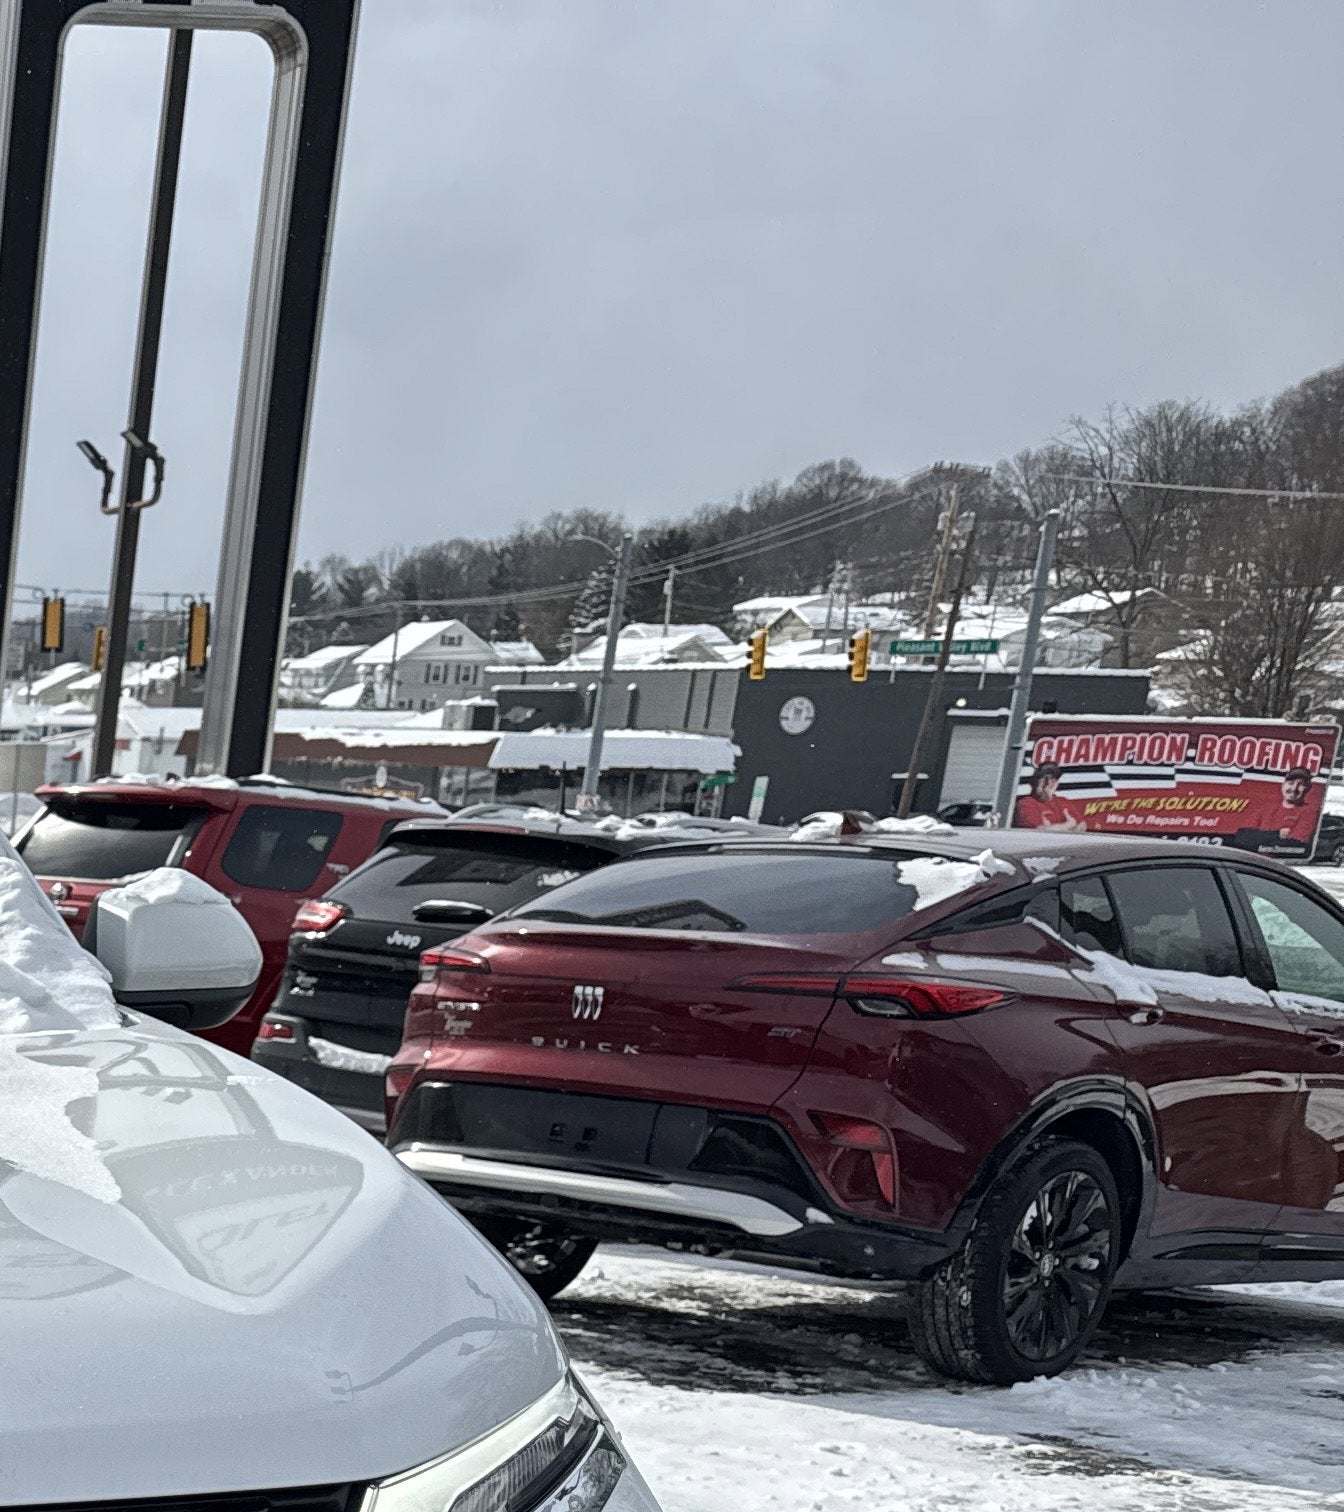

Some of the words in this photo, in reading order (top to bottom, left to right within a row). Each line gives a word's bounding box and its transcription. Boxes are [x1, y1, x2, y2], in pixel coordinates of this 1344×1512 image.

[1031, 732, 1189, 769] CHAMPION
[1195, 733, 1324, 776] ROOFING
[1156, 796, 1250, 814] SOLUTION!
[1105, 813, 1126, 826] We
[1126, 814, 1145, 826] Do
[1144, 814, 1191, 828] Repairs
[1192, 815, 1219, 828] Too!
[386, 930, 421, 949] Jeep
[531, 1035, 640, 1055] BUICK
